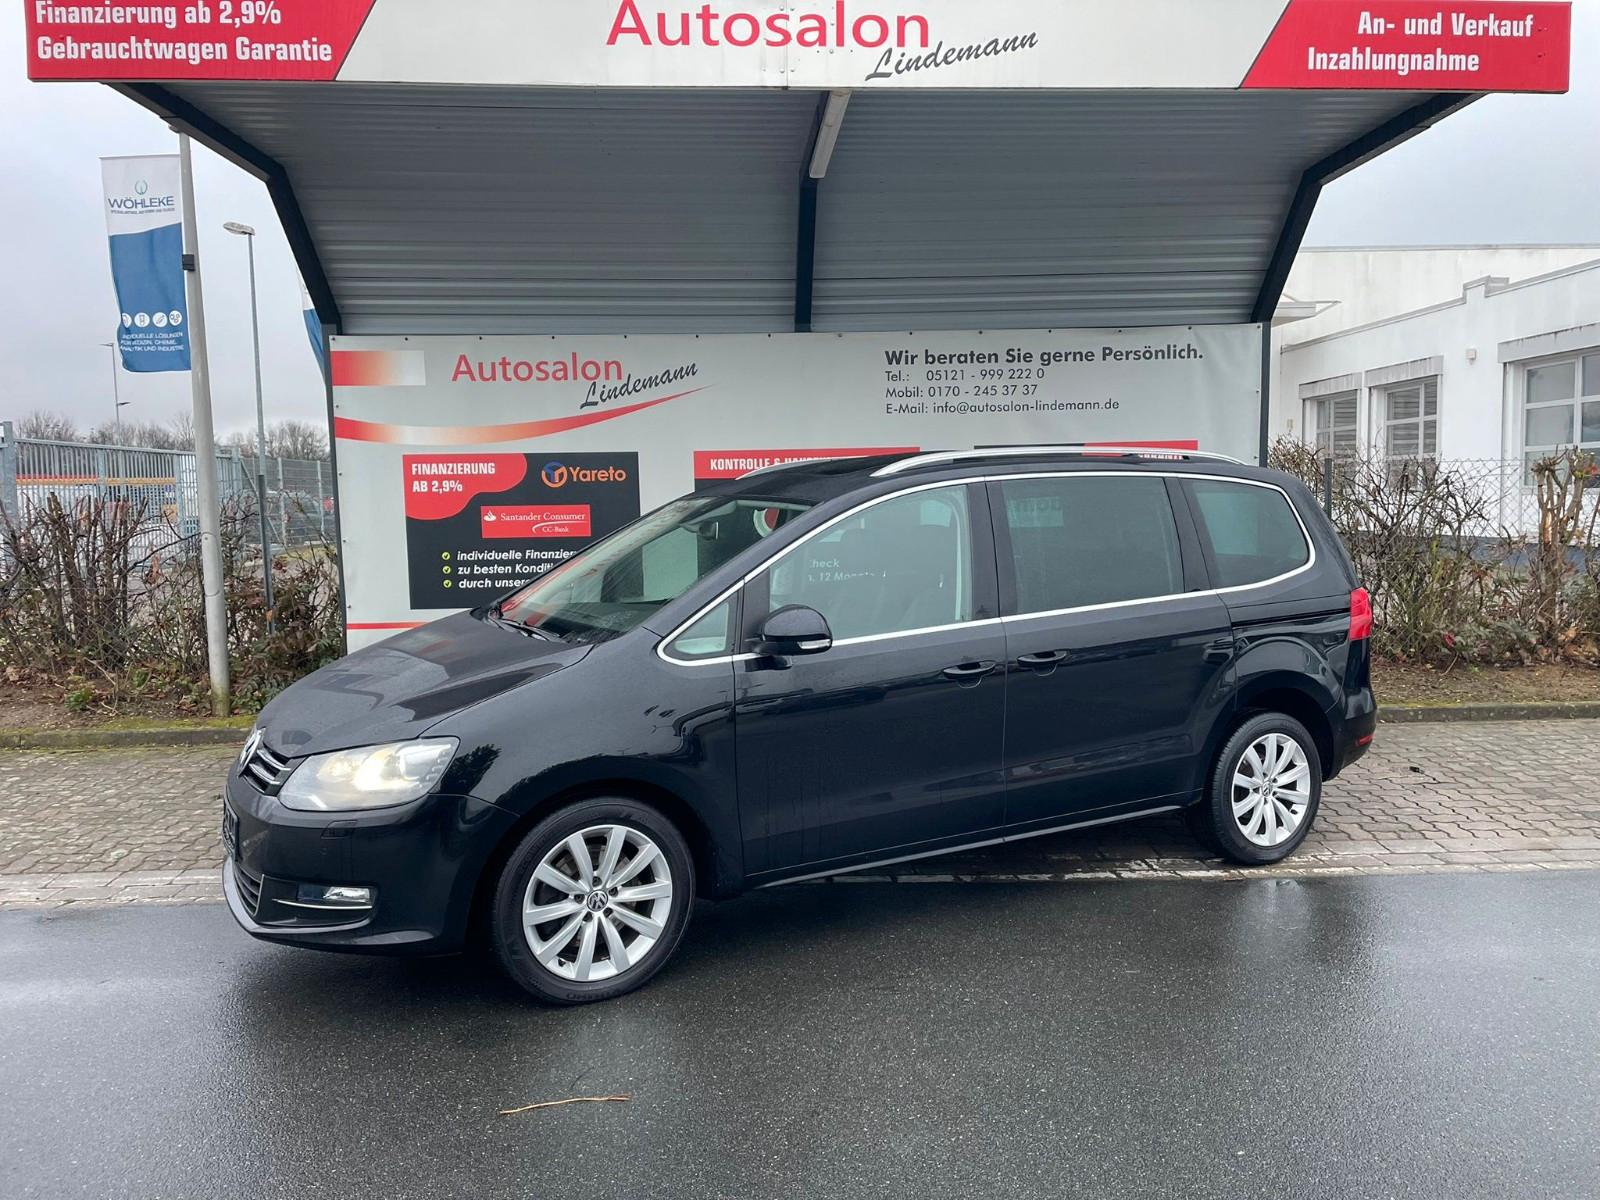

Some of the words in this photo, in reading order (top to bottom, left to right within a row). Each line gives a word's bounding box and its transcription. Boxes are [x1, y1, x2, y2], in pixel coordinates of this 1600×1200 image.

[36, 1, 177, 29] Finanzierung
[184, 0, 210, 24] ab
[219, 1, 281, 28] 2,9%
[606, 0, 930, 48] Autosalon
[1357, 11, 1395, 35] An-
[1404, 12, 1442, 36] und
[1451, 12, 1534, 37] Verkauf
[37, 35, 228, 65] Gebrauchtwagen
[235, 36, 332, 62] Garantie
[865, 28, 1039, 81] Lindemann
[1308, 47, 1480, 76] Inzahlungnahme
[108, 195, 175, 209] WÖHLEKE
[885, 350, 918, 365] Wir
[925, 349, 999, 365] beraten
[1005, 348, 1034, 363] Sie
[1040, 350, 1096, 366] gerne
[1102, 343, 1203, 361] Persönlich.
[451, 352, 623, 382] Autosalon
[885, 370, 910, 382] Tel.:
[926, 369, 965, 381] 05121
[980, 369, 1004, 380] 999
[1008, 368, 1032, 380] 222
[1036, 368, 1045, 379] 0
[580, 360, 698, 409] Lindemann
[885, 386, 924, 398] Mobil:
[928, 386, 960, 397] 0170
[973, 385, 998, 396] 245
[1002, 384, 1018, 396] 37
[1022, 384, 1038, 396] 37
[886, 402, 928, 414] E-Mail:
[933, 398, 1120, 415] info@autosalon-lindemann.de
[411, 462, 496, 475] FINANZIERUNG
[710, 458, 770, 470] KONTROLLE
[569, 466, 626, 483] Yareto
[412, 480, 428, 492] AB
[432, 480, 463, 494] 2,9%
[500, 513, 541, 521] Santander
[543, 512, 586, 521] Consumer
[457, 550, 522, 561] individuelle
[457, 567, 471, 575] zu
[474, 565, 513, 575] besten
[458, 577, 491, 588] durch
